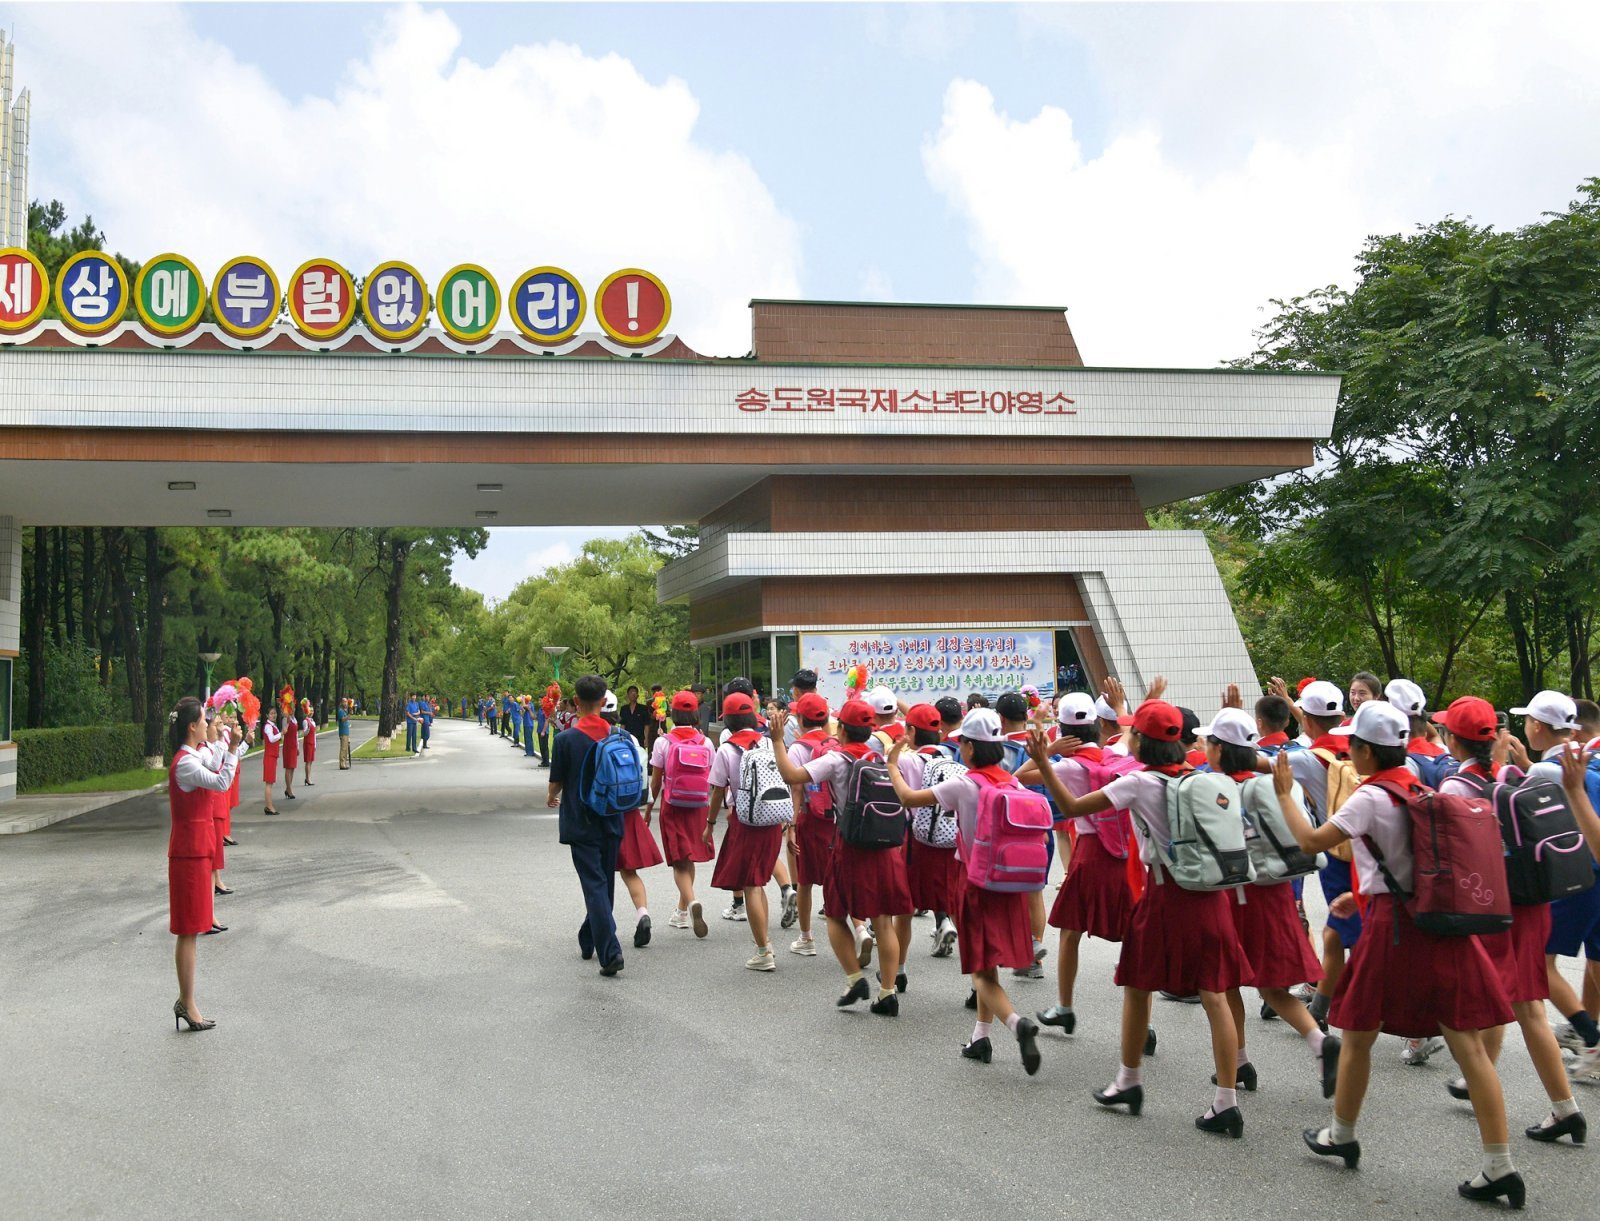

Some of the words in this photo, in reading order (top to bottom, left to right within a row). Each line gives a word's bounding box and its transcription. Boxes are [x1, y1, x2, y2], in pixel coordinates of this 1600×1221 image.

[735, 387, 1077, 415] 송도원국제소년단야영소
[849, 640, 892, 654] 경애하는
[898, 639, 929, 652] 아버지
[866, 657, 897, 671] 사랑과
[990, 655, 1031, 667] 참가하는
[963, 673, 1020, 687] 축하합니다!
